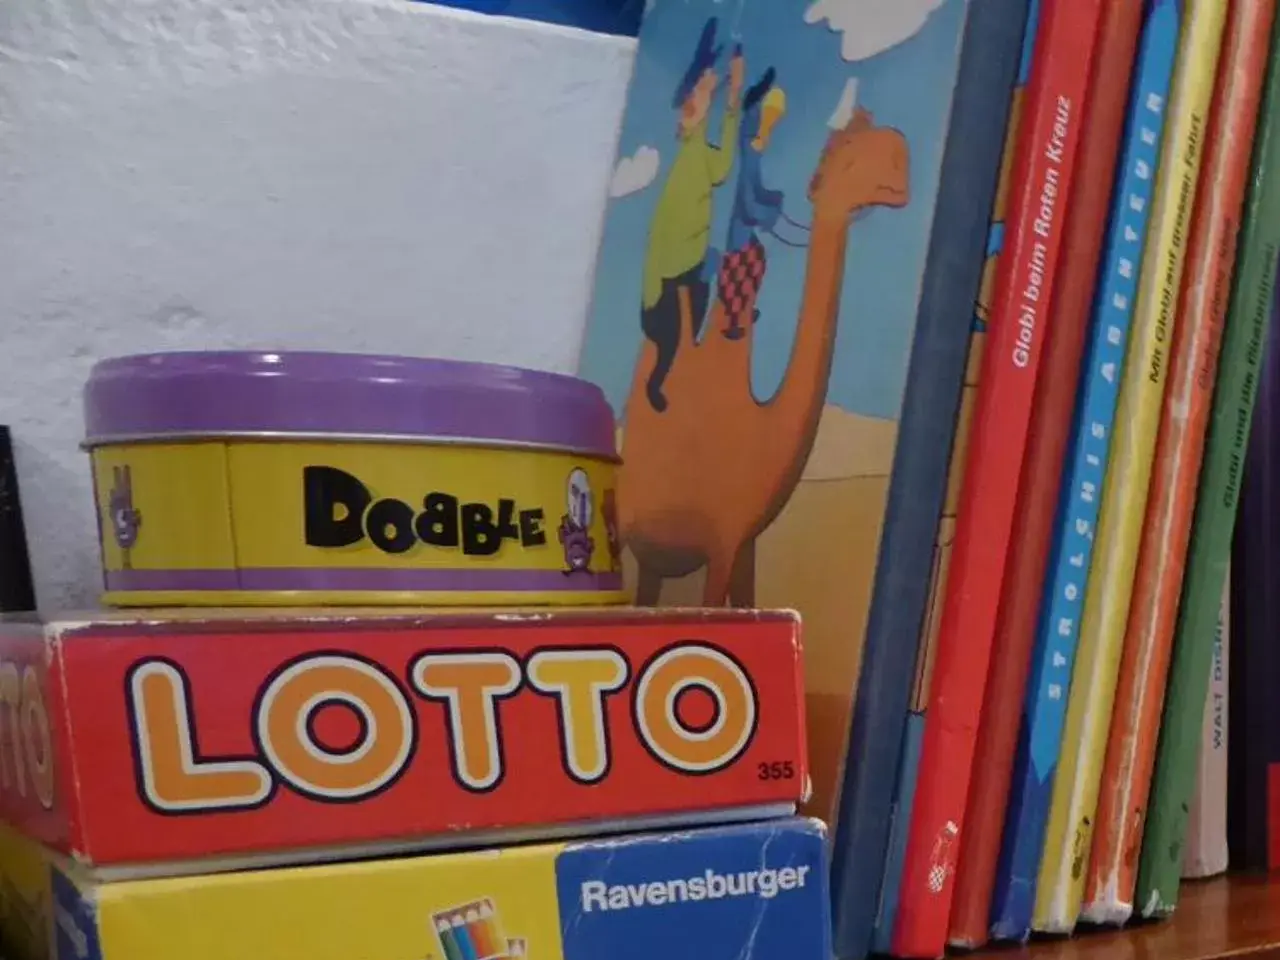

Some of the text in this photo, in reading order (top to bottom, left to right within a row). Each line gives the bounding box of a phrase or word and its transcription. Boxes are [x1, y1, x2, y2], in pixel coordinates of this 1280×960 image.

[1012, 95, 1072, 369] Globi beim Roten Kreuz
[1149, 344, 1164, 384] Mit
[130, 640, 760, 816] LOTTO
[757, 762, 795, 781] 355
[580, 862, 811, 914] Ravensburger
